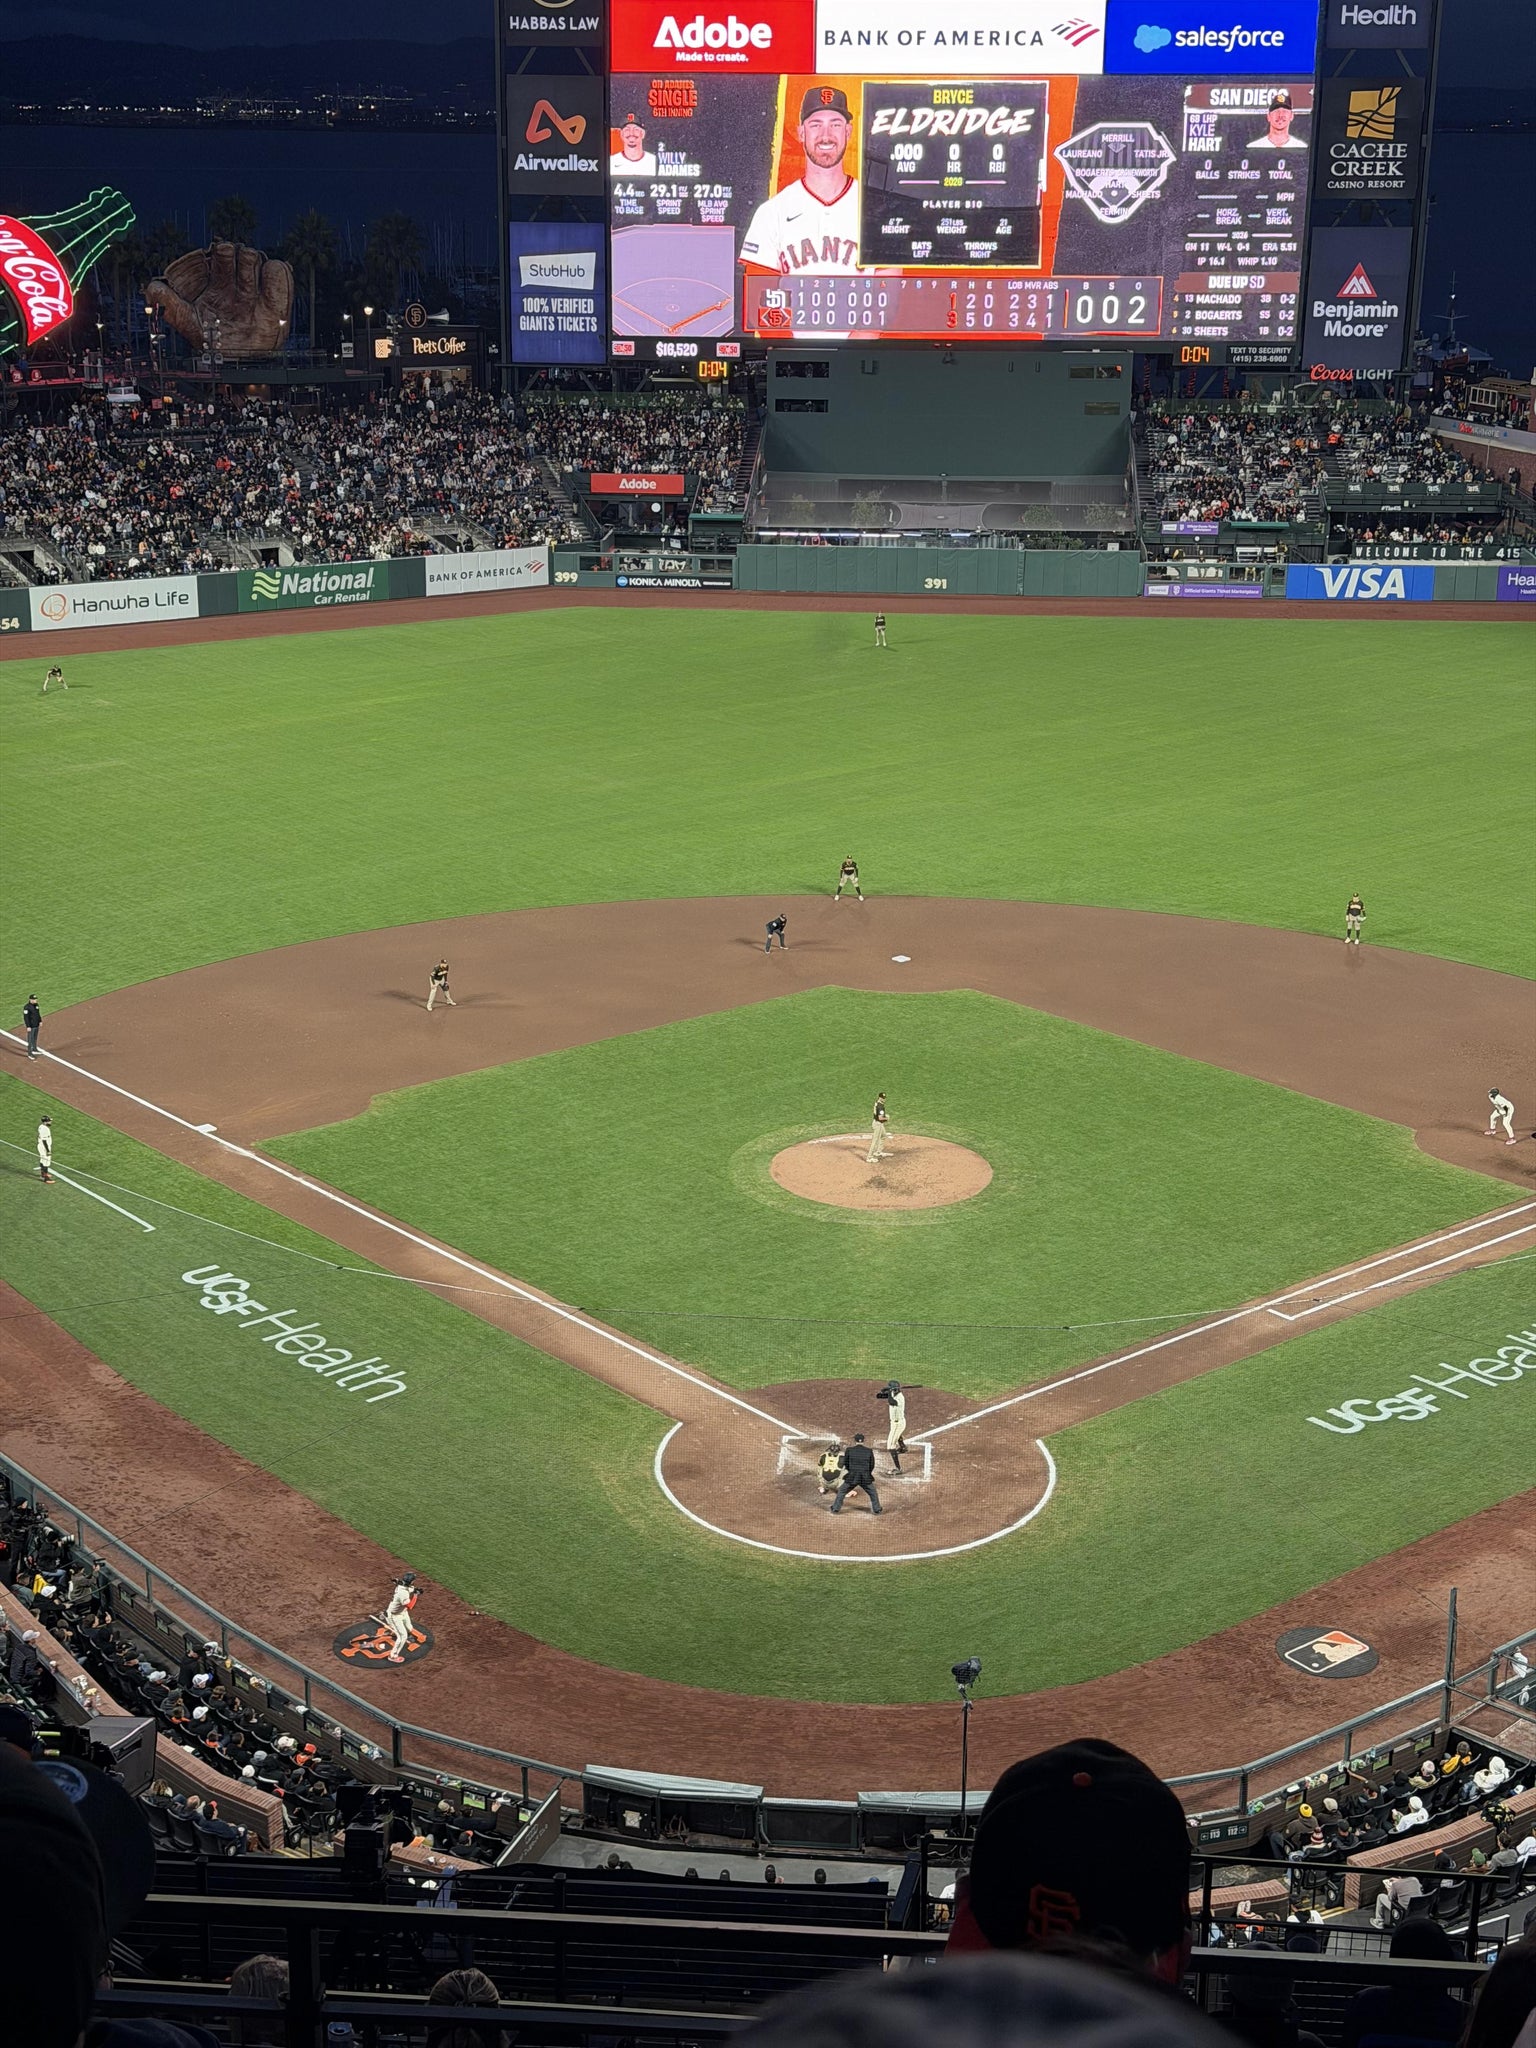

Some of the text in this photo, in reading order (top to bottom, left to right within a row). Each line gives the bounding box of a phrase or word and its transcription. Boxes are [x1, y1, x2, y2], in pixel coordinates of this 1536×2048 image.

[1341, 4, 1416, 26] Health
[510, 16, 599, 30] HABBAS LAW
[652, 16, 772, 48] Adobe
[824, 30, 1044, 46] BANK OF AMERICA
[1174, 25, 1284, 52] salesforce
[676, 52, 748, 62] Made to create.
[648, 89, 698, 106] SINGLE
[933, 90, 974, 104] BRYCE
[1210, 88, 1241, 106] SAN
[668, 108, 693, 118] INNING
[1202, 114, 1218, 123] LHP
[870, 106, 1034, 136] ELDRIDGE
[1189, 124, 1215, 136] KYLE
[1102, 134, 1135, 142] MERRILL
[1188, 136, 1222, 152] HART
[890, 144, 923, 160] .000
[949, 144, 960, 160] 0
[992, 144, 1003, 160] 0
[1062, 150, 1102, 158] LAUREANO
[1134, 150, 1156, 158] TATIS
[1330, 143, 1408, 158] CACHE
[514, 154, 599, 172] Airwallex
[658, 152, 686, 164] WILLY
[658, 164, 700, 176] ADAMES
[896, 162, 916, 173] AVG
[946, 162, 961, 173] HR
[989, 162, 1006, 173] RBI
[1331, 161, 1404, 176] CREEK
[1196, 171, 1220, 180] BALLS
[1228, 171, 1260, 180] STRIKES
[1268, 171, 1293, 180] TOTAL
[1106, 180, 1125, 188] HART
[1328, 180, 1406, 189] CASINO RESORT
[614, 183, 634, 198] 4.4
[650, 184, 678, 198] 29.1
[694, 184, 722, 198] 27.0
[1066, 190, 1103, 198] MACHADO
[1131, 190, 1160, 198] SHEETS
[1276, 192, 1295, 201] MPH
[620, 199, 637, 207] TIME
[656, 200, 682, 208] SPRINT
[698, 200, 728, 208] MLB AVG
[922, 200, 960, 209] PLAYER
[614, 206, 644, 214] TO BASE
[700, 207, 726, 215] SPRINT
[1216, 208, 1240, 216] HORZ.
[1266, 208, 1288, 216] VERT.
[702, 214, 724, 222] SPEED
[1216, 216, 1242, 224] BREAK
[1266, 216, 1292, 224] BREAK
[882, 225, 910, 234] HEIGHT
[936, 225, 968, 234] WEIGHT
[996, 226, 1012, 234] AGE
[912, 242, 932, 250] BATS
[964, 242, 998, 250] THROWS
[1185, 243, 1210, 252] GM 11
[1216, 243, 1232, 252] W-L
[1262, 243, 1278, 252] ERA
[779, 236, 863, 274] GIANT
[913, 250, 930, 258] LEFT
[970, 250, 991, 258] RIGHT
[1198, 258, 1226, 266] IP 16.1
[1237, 257, 1278, 266] WHIP 1.10
[529, 264, 586, 278] StubHub
[1008, 282, 1058, 290] LOB MVR ABS
[1208, 275, 1265, 288] DUE UP SD
[1196, 294, 1296, 304] MACHADO 0-2
[522, 298, 594, 314] 100% VERIFIED
[1076, 296, 1146, 324] 0 0 2
[1312, 300, 1398, 322] Benjamin
[1195, 310, 1294, 320] BOGAERTS 0-2
[520, 316, 598, 332] GIANTS TICKETS
[1324, 320, 1384, 337] Moore
[1194, 326, 1294, 336] SHEETS 0-2
[412, 337, 466, 354] Peet's Coffee
[656, 341, 698, 358] $16,520
[1258, 346, 1292, 354] SECURITY
[1181, 346, 1210, 362] 0:04
[698, 361, 728, 378] 0:04
[1310, 364, 1394, 380] Coors LIGHT
[618, 478, 656, 490] Adobe
[1356, 546, 1418, 557] WELCOME
[1432, 547, 1446, 558] TO
[1460, 547, 1483, 558] THE
[1496, 548, 1520, 558] 415
[429, 566, 522, 582] BANK OF AMERICA
[554, 572, 578, 584] 399
[1508, 573, 1536, 586] Hea
[282, 566, 374, 596] National
[628, 578, 662, 586] KONICA
[664, 578, 702, 587] MINOLTA
[924, 578, 948, 590] 391
[1314, 568, 1406, 598] VISA
[73, 591, 189, 614] Hanwha Life
[314, 590, 370, 606] Car Rental
[0, 617, 20, 630] 54
[182, 1264, 406, 1403] UCSF Health
[1306, 1387, 1442, 1434] UCSF
